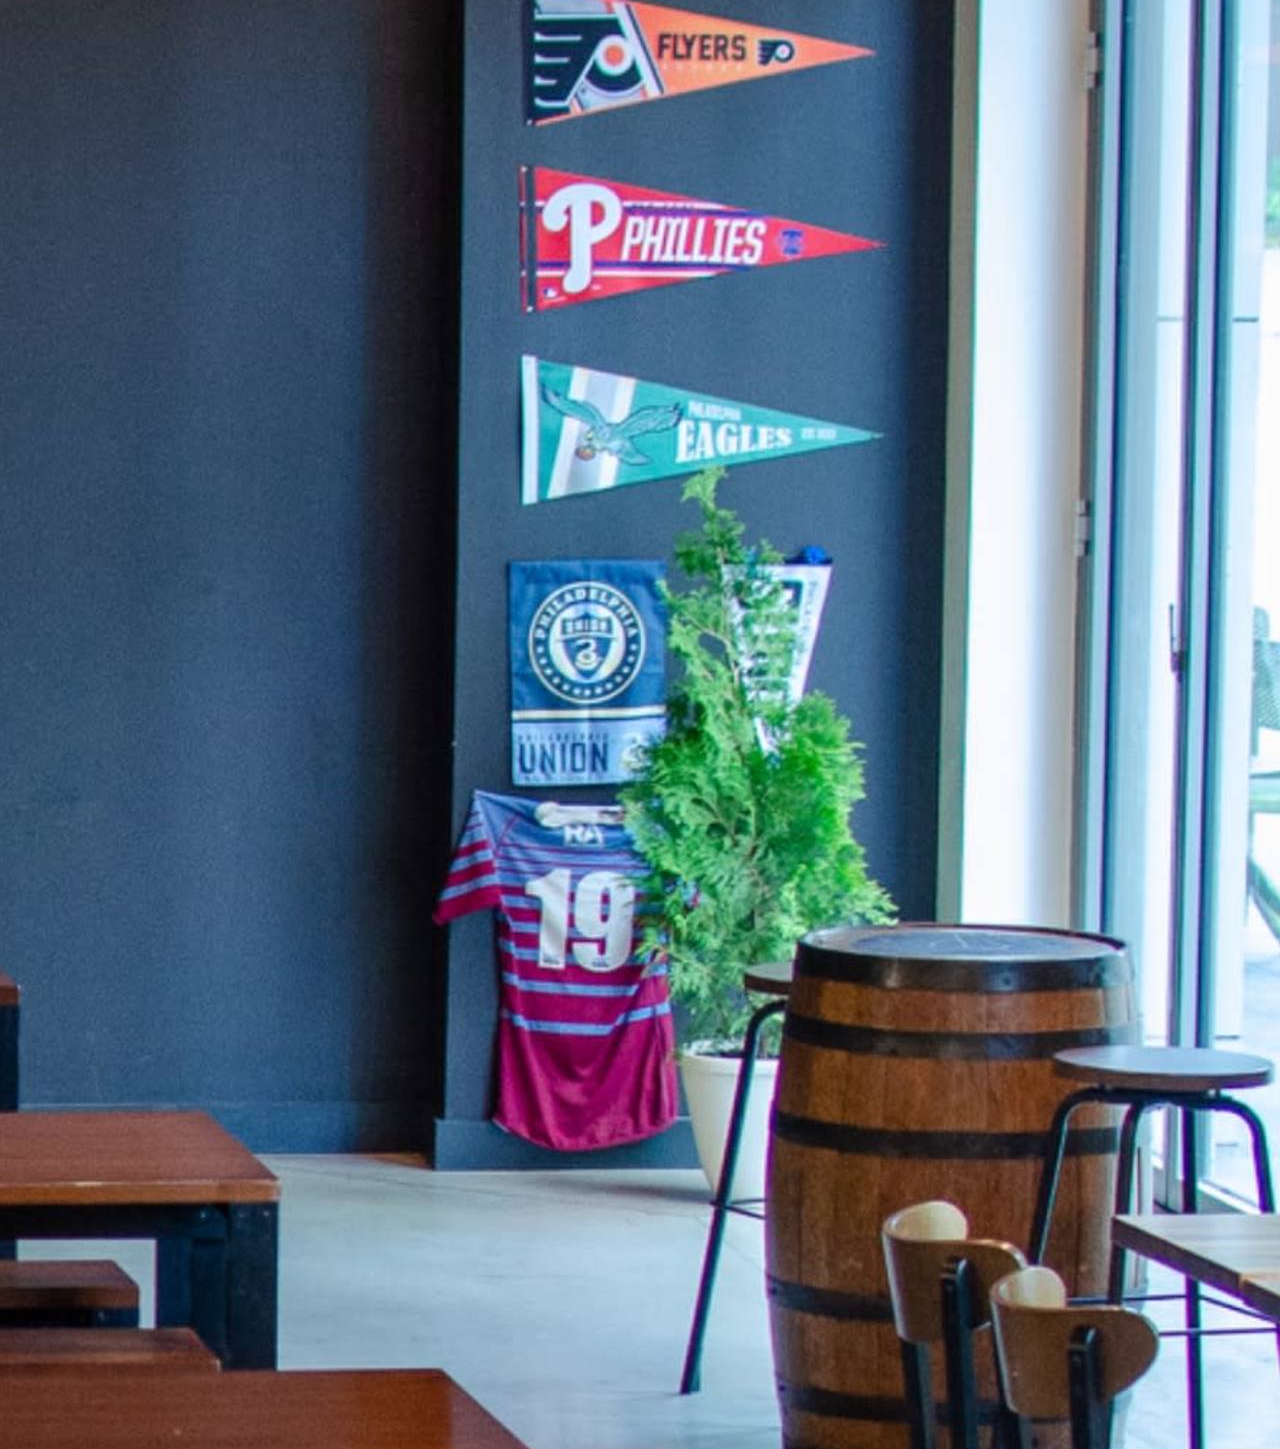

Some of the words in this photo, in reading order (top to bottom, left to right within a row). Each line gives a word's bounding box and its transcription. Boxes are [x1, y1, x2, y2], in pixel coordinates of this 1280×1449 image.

[657, 33, 748, 61] FLYERS
[621, 216, 765, 264] PHILLIES
[675, 419, 793, 464] EAGLES
[534, 587, 639, 640] PHILADELPHIA
[518, 742, 608, 774] UNION
[524, 867, 635, 973] 19
